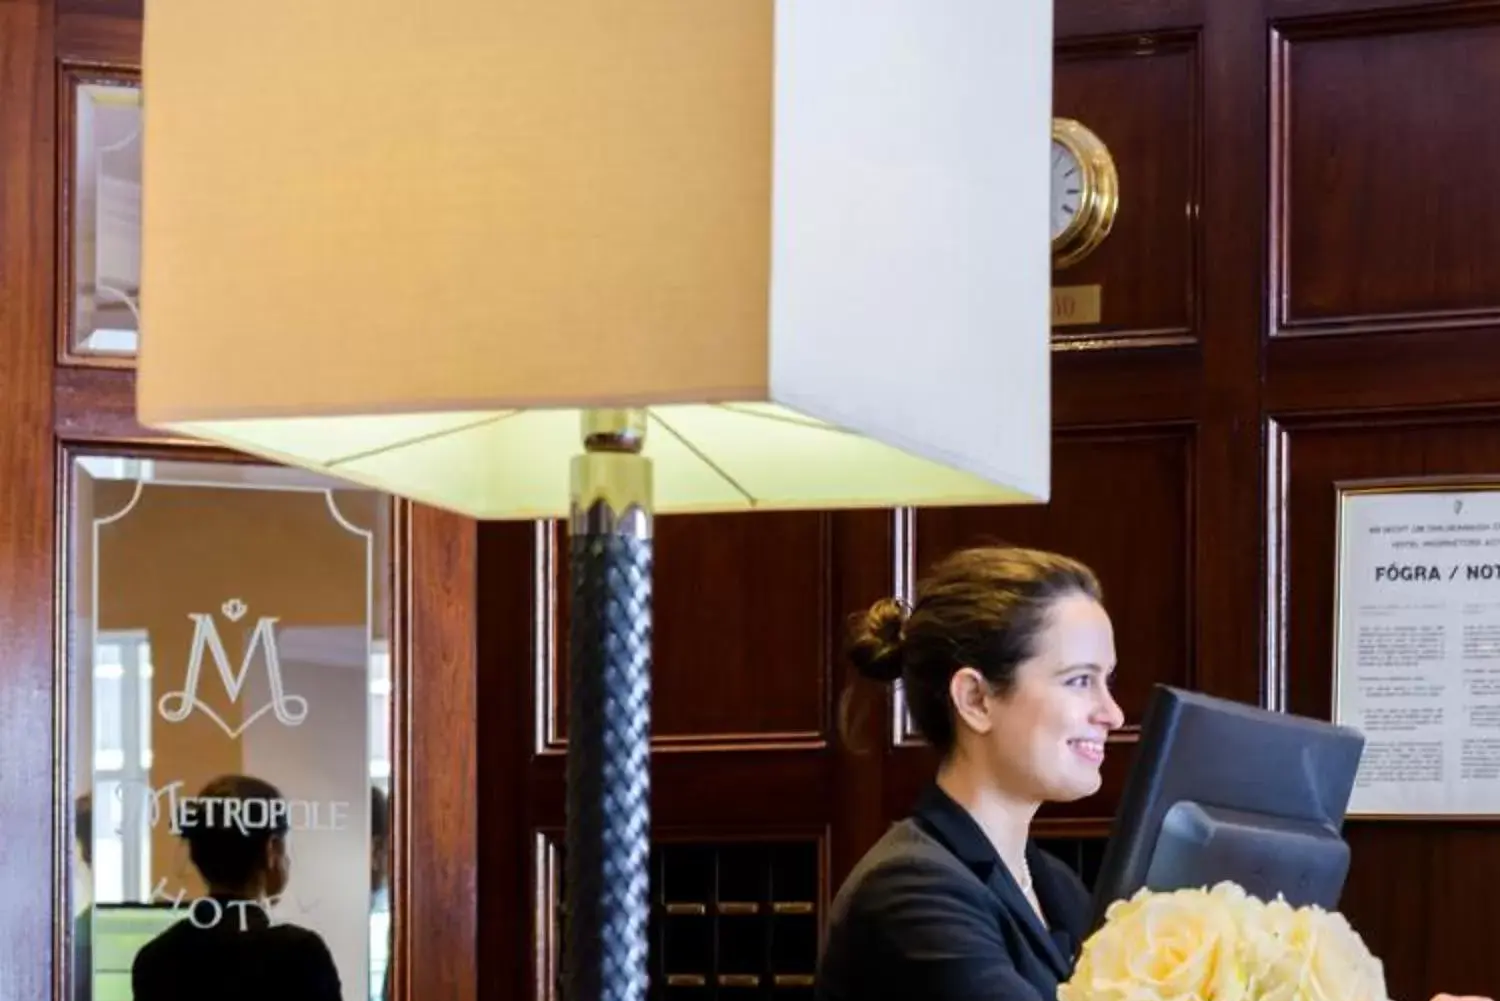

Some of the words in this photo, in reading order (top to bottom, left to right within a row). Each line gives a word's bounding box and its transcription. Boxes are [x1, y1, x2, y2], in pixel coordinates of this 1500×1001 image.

[1374, 561, 1441, 582] FÓGRA
[1448, 565, 1459, 581] /
[115, 780, 350, 836] METROPOLE
